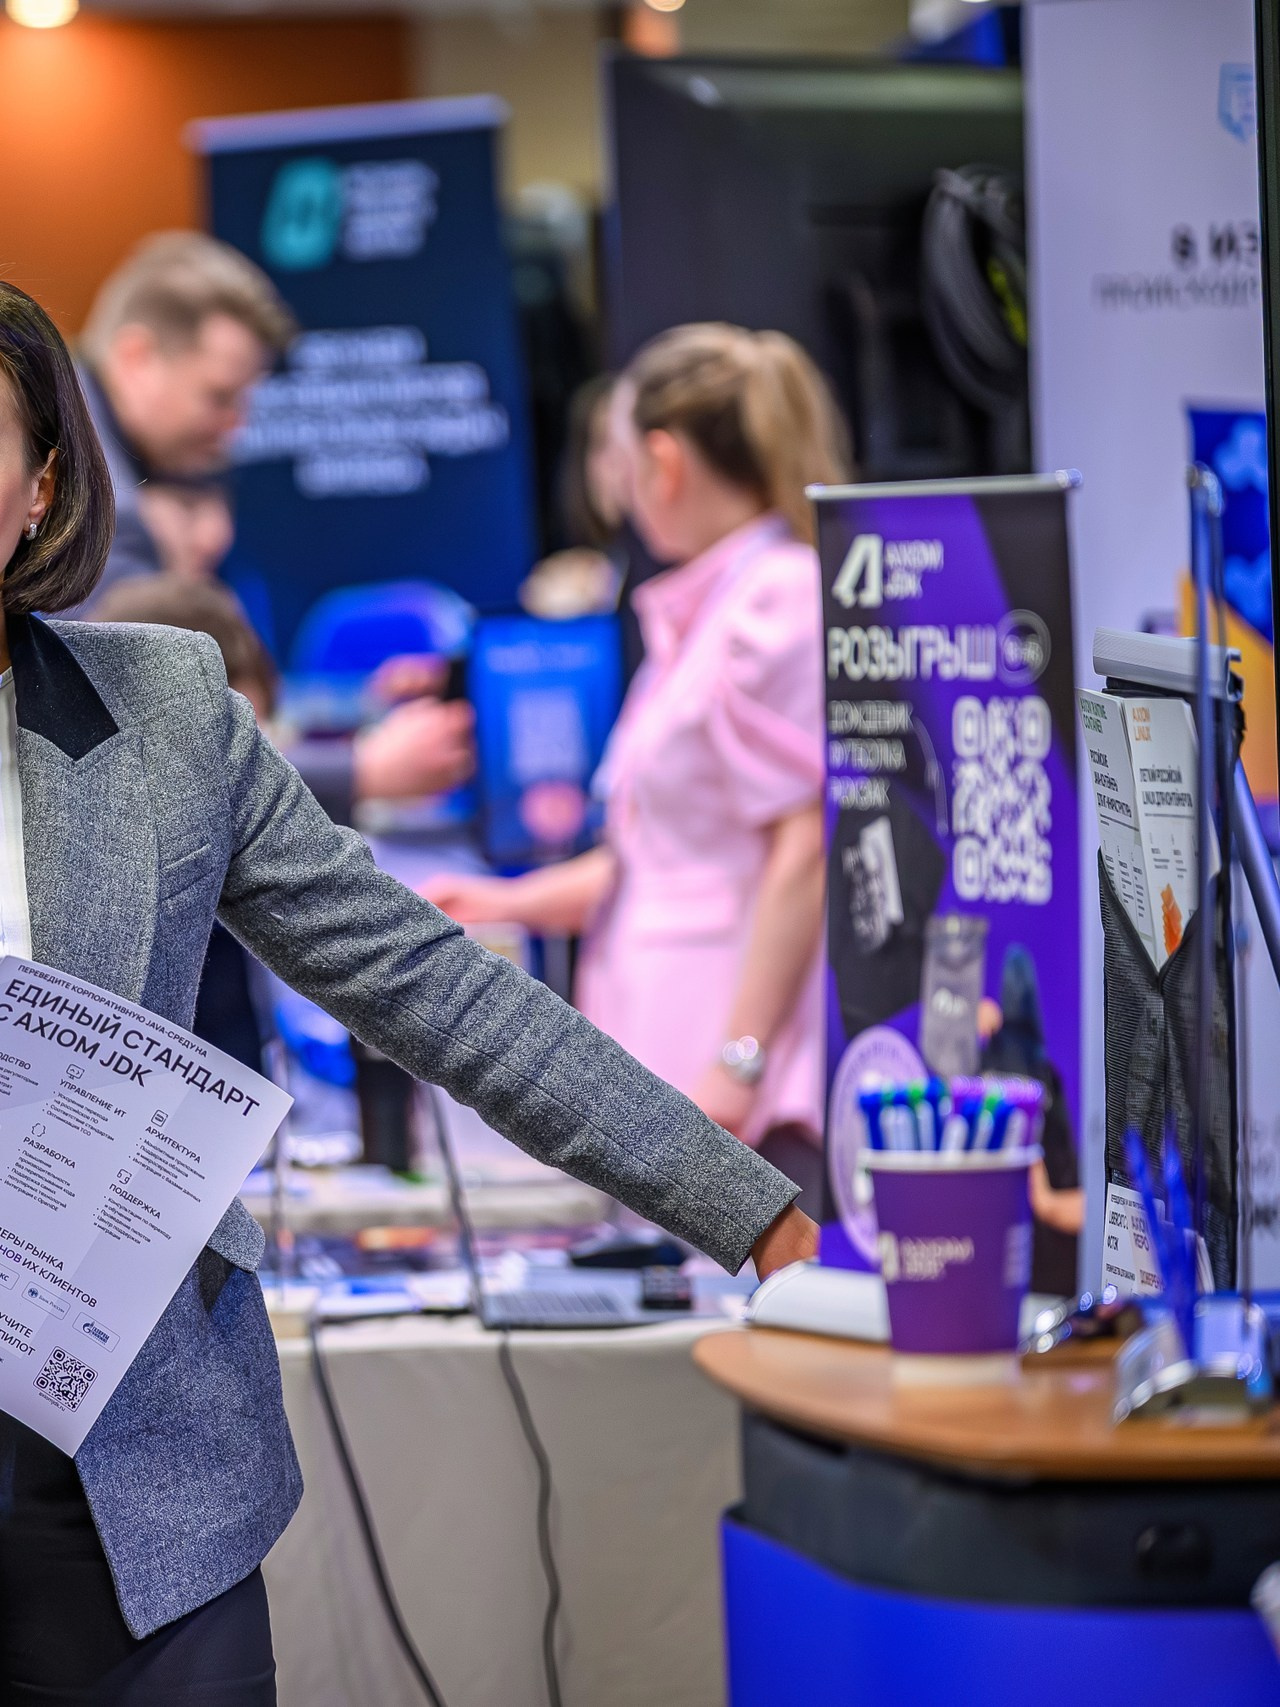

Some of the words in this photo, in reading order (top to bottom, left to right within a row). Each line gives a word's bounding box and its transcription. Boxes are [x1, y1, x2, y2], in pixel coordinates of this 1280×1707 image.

[827, 624, 997, 682] РОЗЫГРЫШ
[18, 965, 71, 989] ПЕРЕВЕДИТЕ
[71, 985, 145, 1023] КОРПОРАТИВНУЮ
[145, 1020, 197, 1050] JAVA-СРЕДУ
[195, 1046, 207, 1058] НА
[5, 979, 122, 1039] ЕДИНЫЙ
[123, 1030, 260, 1116] СТАНДАРТ
[13, 1012, 100, 1060] AXIOM
[99, 1051, 153, 1088] JDK
[59, 1079, 114, 1111] УПРАВЛЕНИЕ
[114, 1107, 127, 1118] ИТ
[23, 1136, 76, 1169] РАЗРАБОТКА
[145, 1126, 201, 1164] АРХИТЕКТУРА
[109, 1183, 161, 1220] ПОДДЕРЖКА
[25, 1242, 64, 1271] РЫНКА
[22, 1258, 40, 1273] ИХ
[38, 1268, 98, 1308] КЛИЕНТОВ
